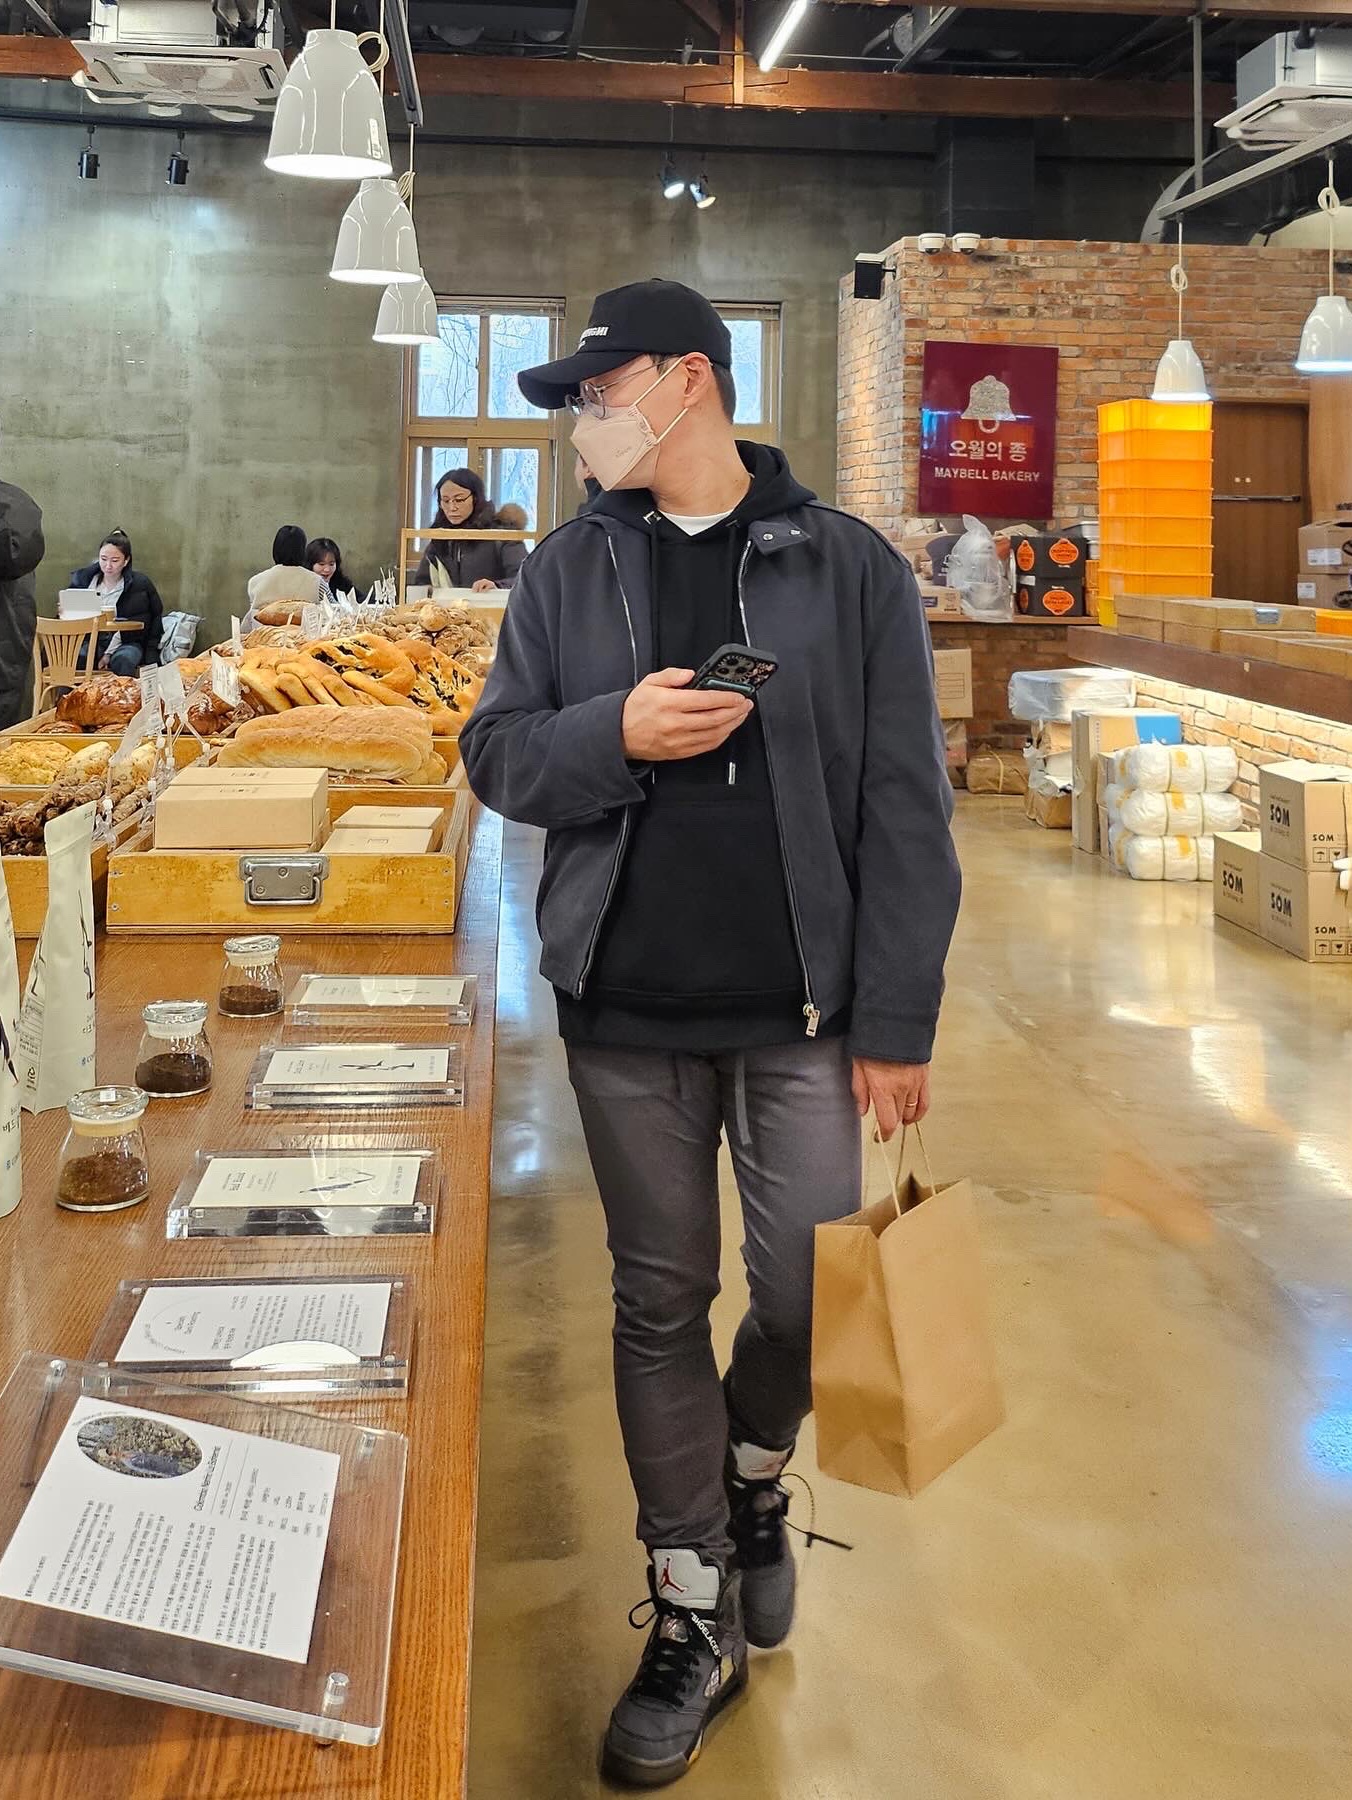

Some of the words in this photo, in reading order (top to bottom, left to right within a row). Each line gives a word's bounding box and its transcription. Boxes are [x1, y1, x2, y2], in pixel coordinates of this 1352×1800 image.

[949, 440, 1002, 461] 오월의
[1009, 442, 1027, 462] 종
[934, 467, 988, 480] MAYBELL
[992, 470, 1040, 482] BAKERY
[1270, 804, 1290, 827] SOM
[1312, 834, 1334, 842] SOM
[1223, 870, 1243, 894] SOM
[1271, 892, 1292, 917] SOM
[1315, 926, 1337, 934] SOM
